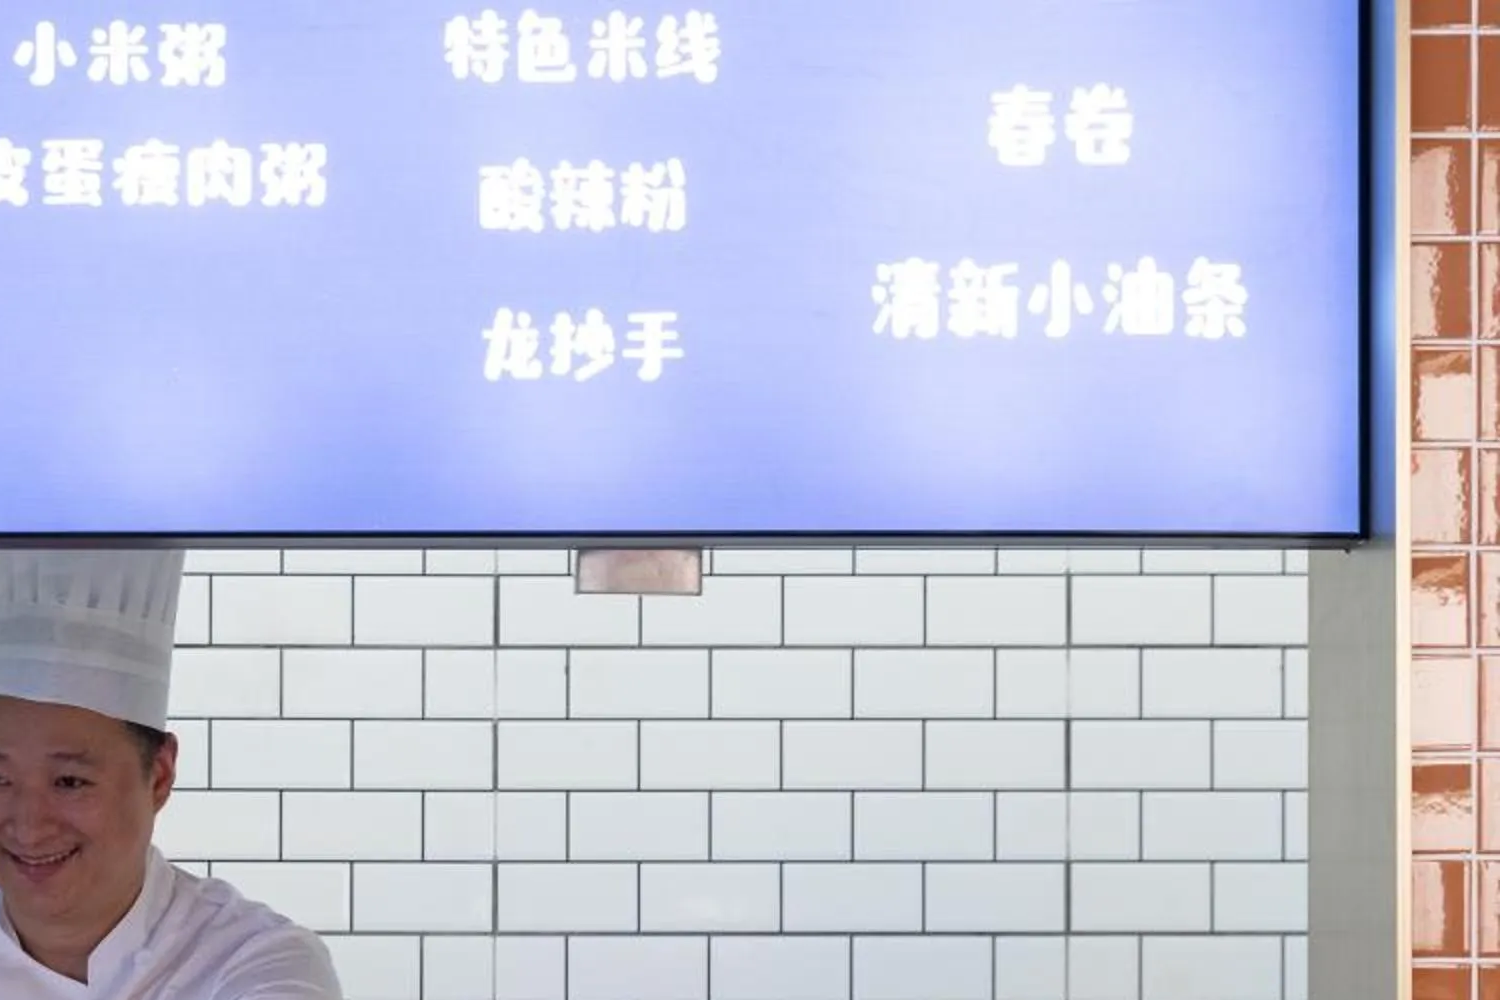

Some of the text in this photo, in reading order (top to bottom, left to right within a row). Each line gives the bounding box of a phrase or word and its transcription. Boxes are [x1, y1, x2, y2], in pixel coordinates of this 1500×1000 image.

[13, 20, 227, 87] 小米粥
[443, 8, 721, 84] 特色米线
[987, 82, 1134, 167] 春卷
[477, 157, 686, 233] 酸辣粉
[870, 255, 1249, 340] 清新小油条
[481, 307, 684, 382] 龙抄手
